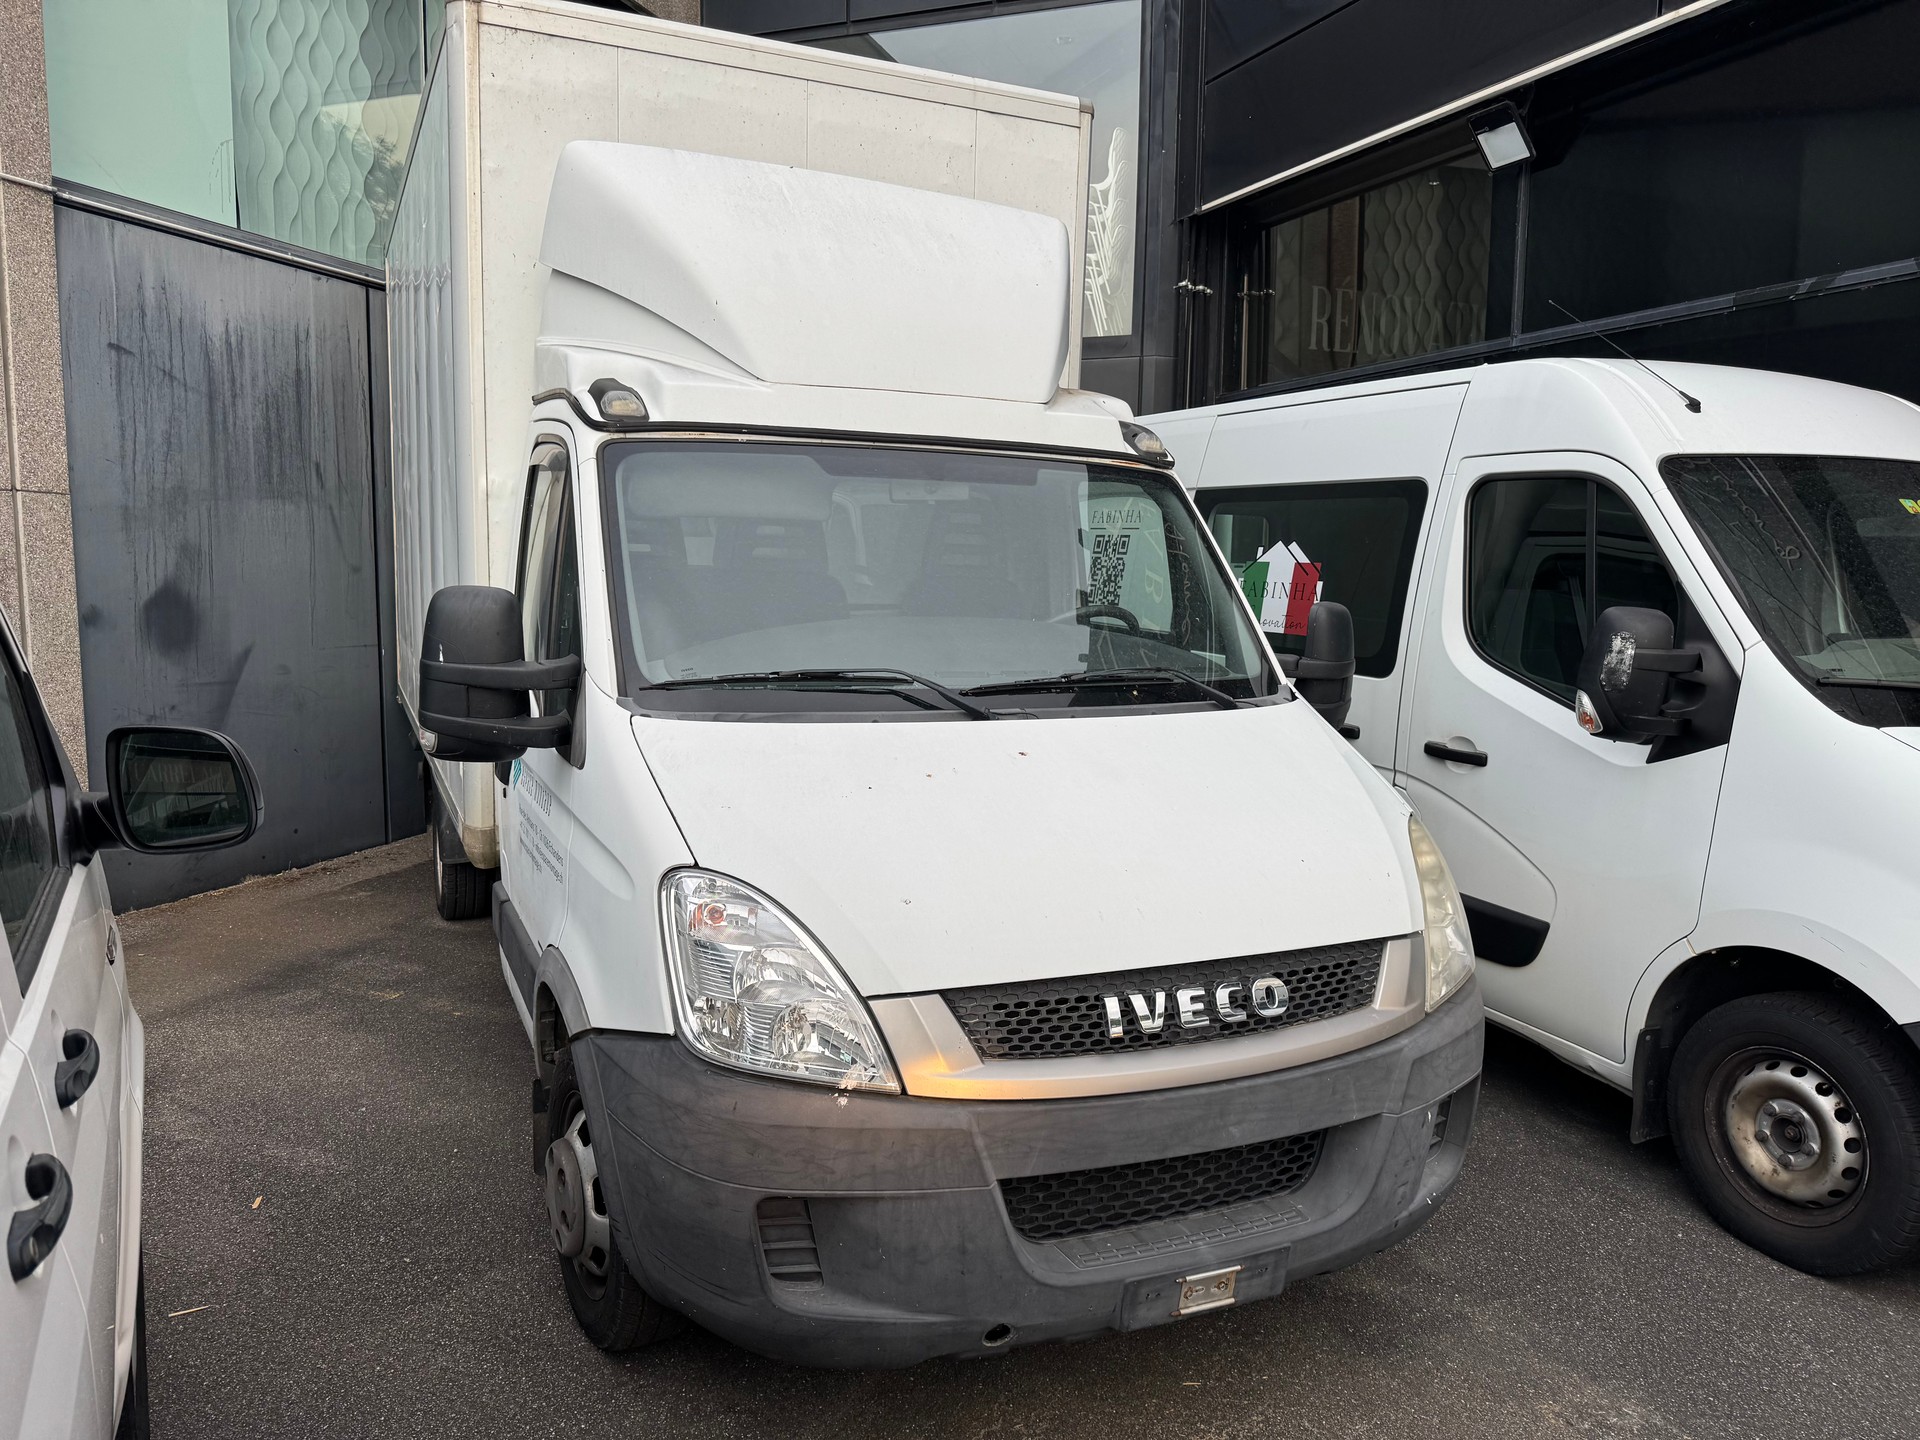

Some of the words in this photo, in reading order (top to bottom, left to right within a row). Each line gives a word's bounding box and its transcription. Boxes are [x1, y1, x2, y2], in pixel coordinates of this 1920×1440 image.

[1308, 275, 1487, 358] RÉNOVATI
[1091, 509, 1143, 525] FABINHA
[1260, 614, 1306, 631] ovation
[1101, 973, 1290, 1039] IVECO
